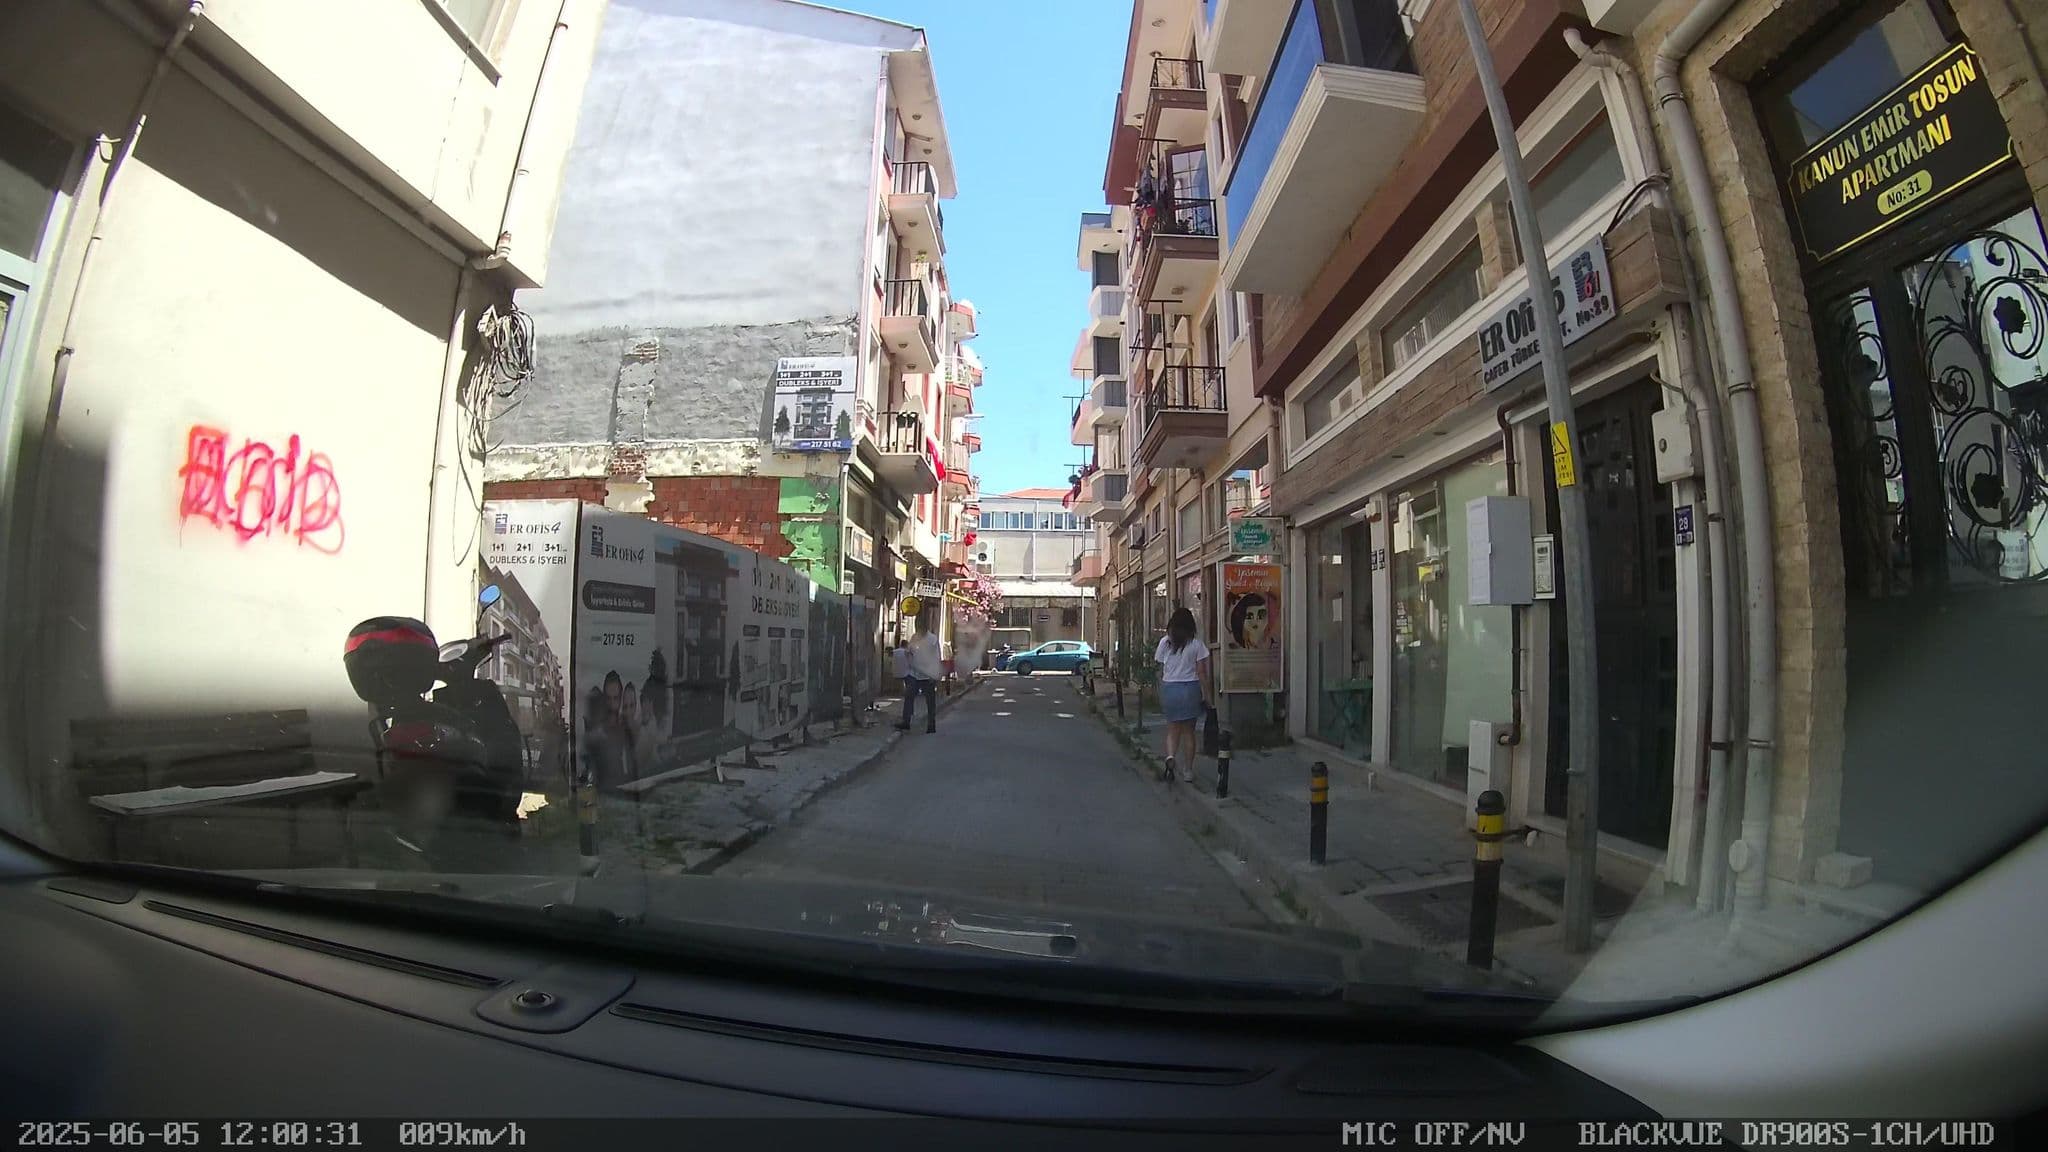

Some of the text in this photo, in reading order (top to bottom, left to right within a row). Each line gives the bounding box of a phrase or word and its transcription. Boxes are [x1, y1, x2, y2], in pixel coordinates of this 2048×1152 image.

[1799, 134, 1860, 194] KANUN
[1908, 54, 1977, 119] TOSUN
[1841, 113, 1953, 205] APARTMANI
[1480, 321, 1505, 363] ER
[1484, 360, 1509, 384] CAFER
[510, 524, 523, 534] ER
[492, 543, 504, 552] 1+1
[516, 543, 532, 552] 2+1
[605, 544, 618, 559] ER
[489, 555, 528, 565] DUBLEKS
[529, 555, 536, 565] &
[603, 632, 635, 647] 217 51 62
